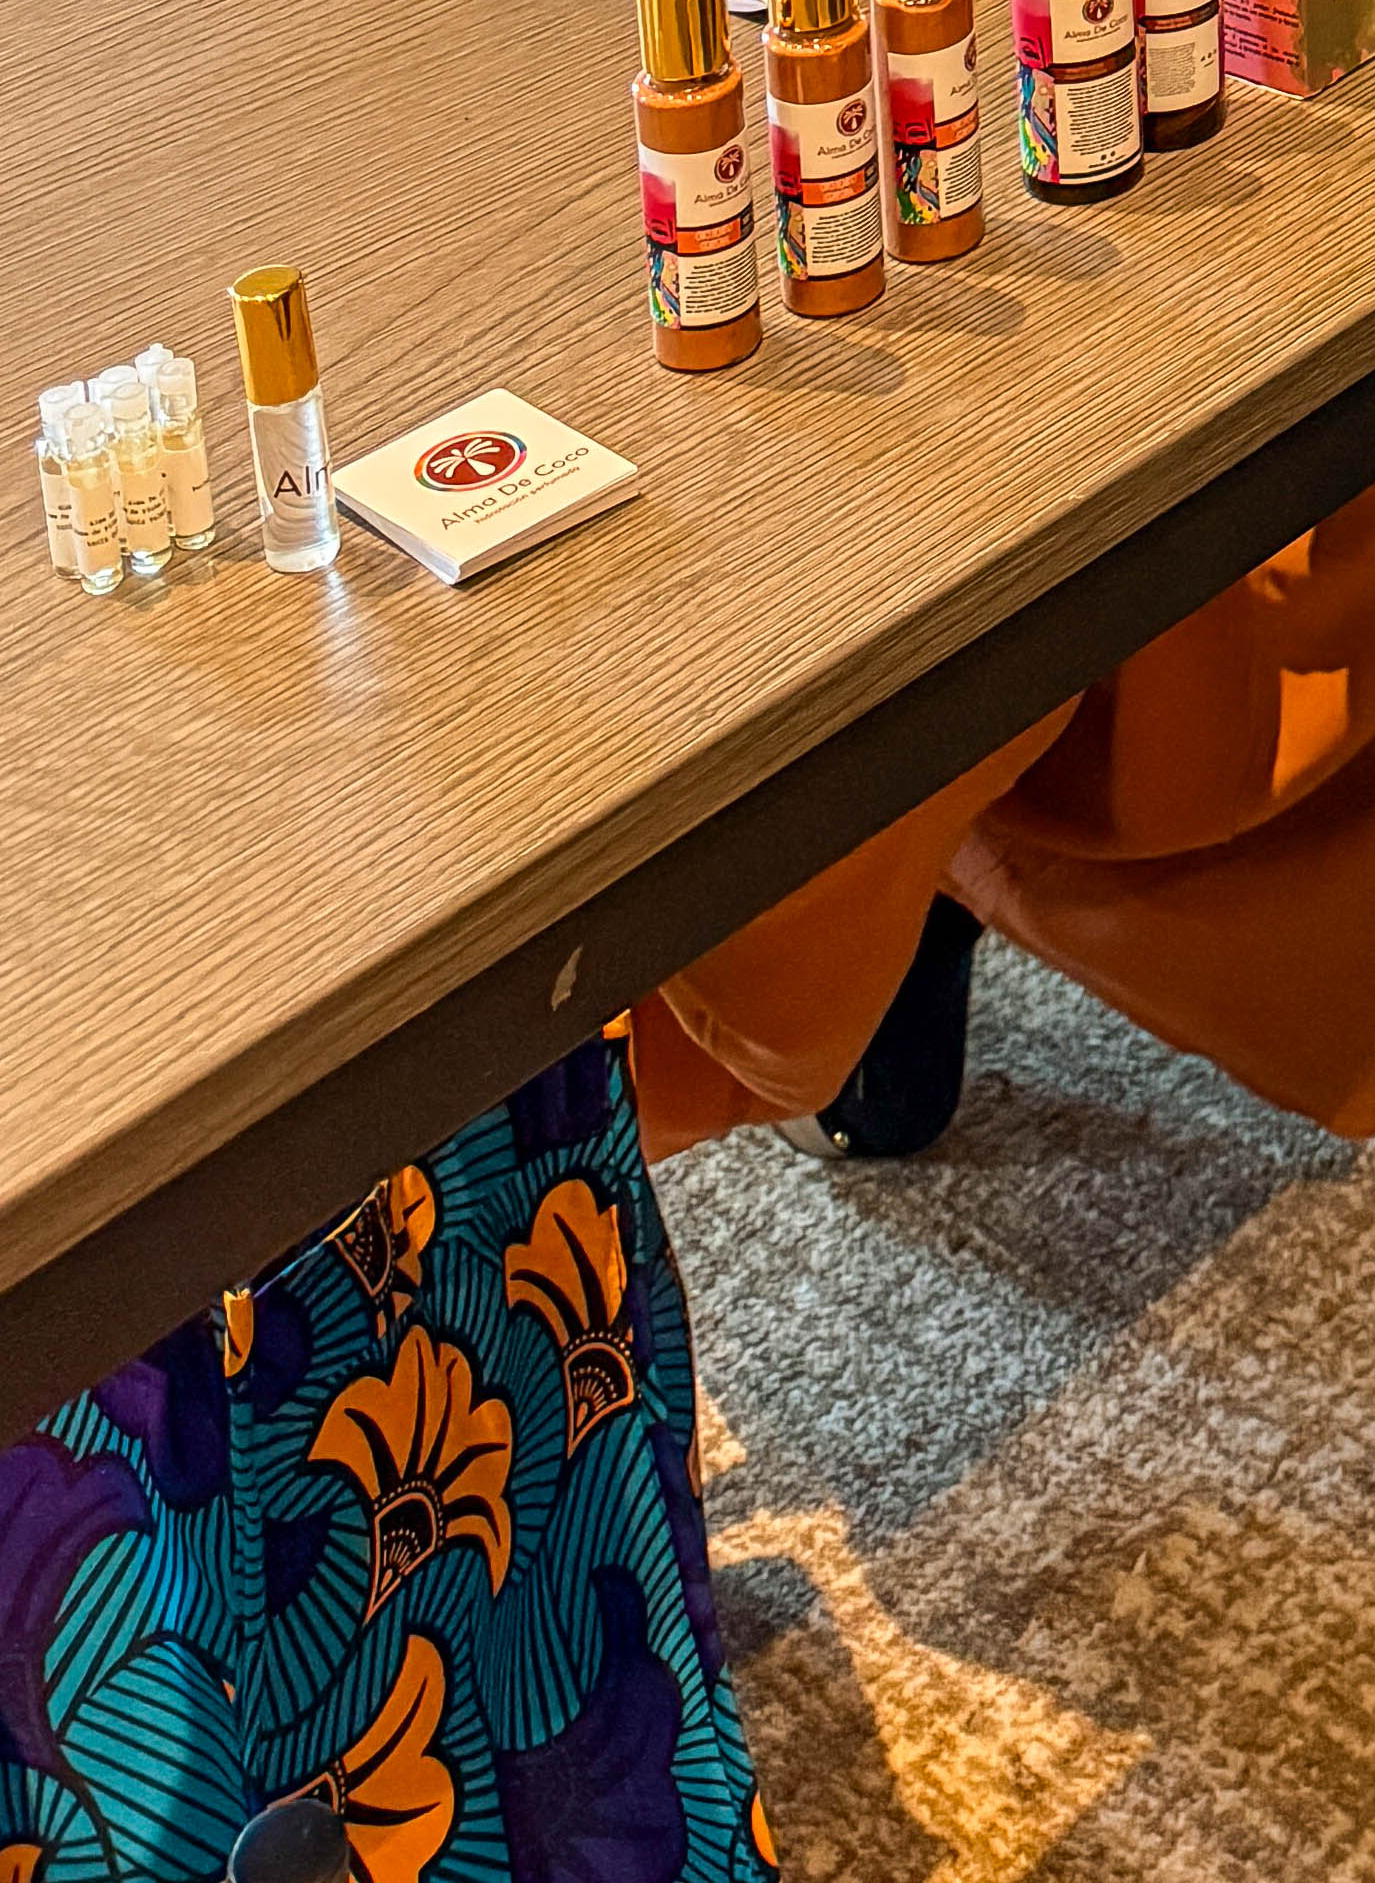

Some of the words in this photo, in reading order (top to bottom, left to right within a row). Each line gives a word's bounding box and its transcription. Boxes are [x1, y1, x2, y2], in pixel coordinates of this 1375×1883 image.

[1064, 27, 1090, 39] Alma
[817, 143, 846, 156] Alma
[849, 137, 861, 148] De
[694, 191, 723, 204] Alma
[440, 495, 497, 531] Alma
[498, 477, 532, 497] De
[533, 446, 590, 476] Coco
